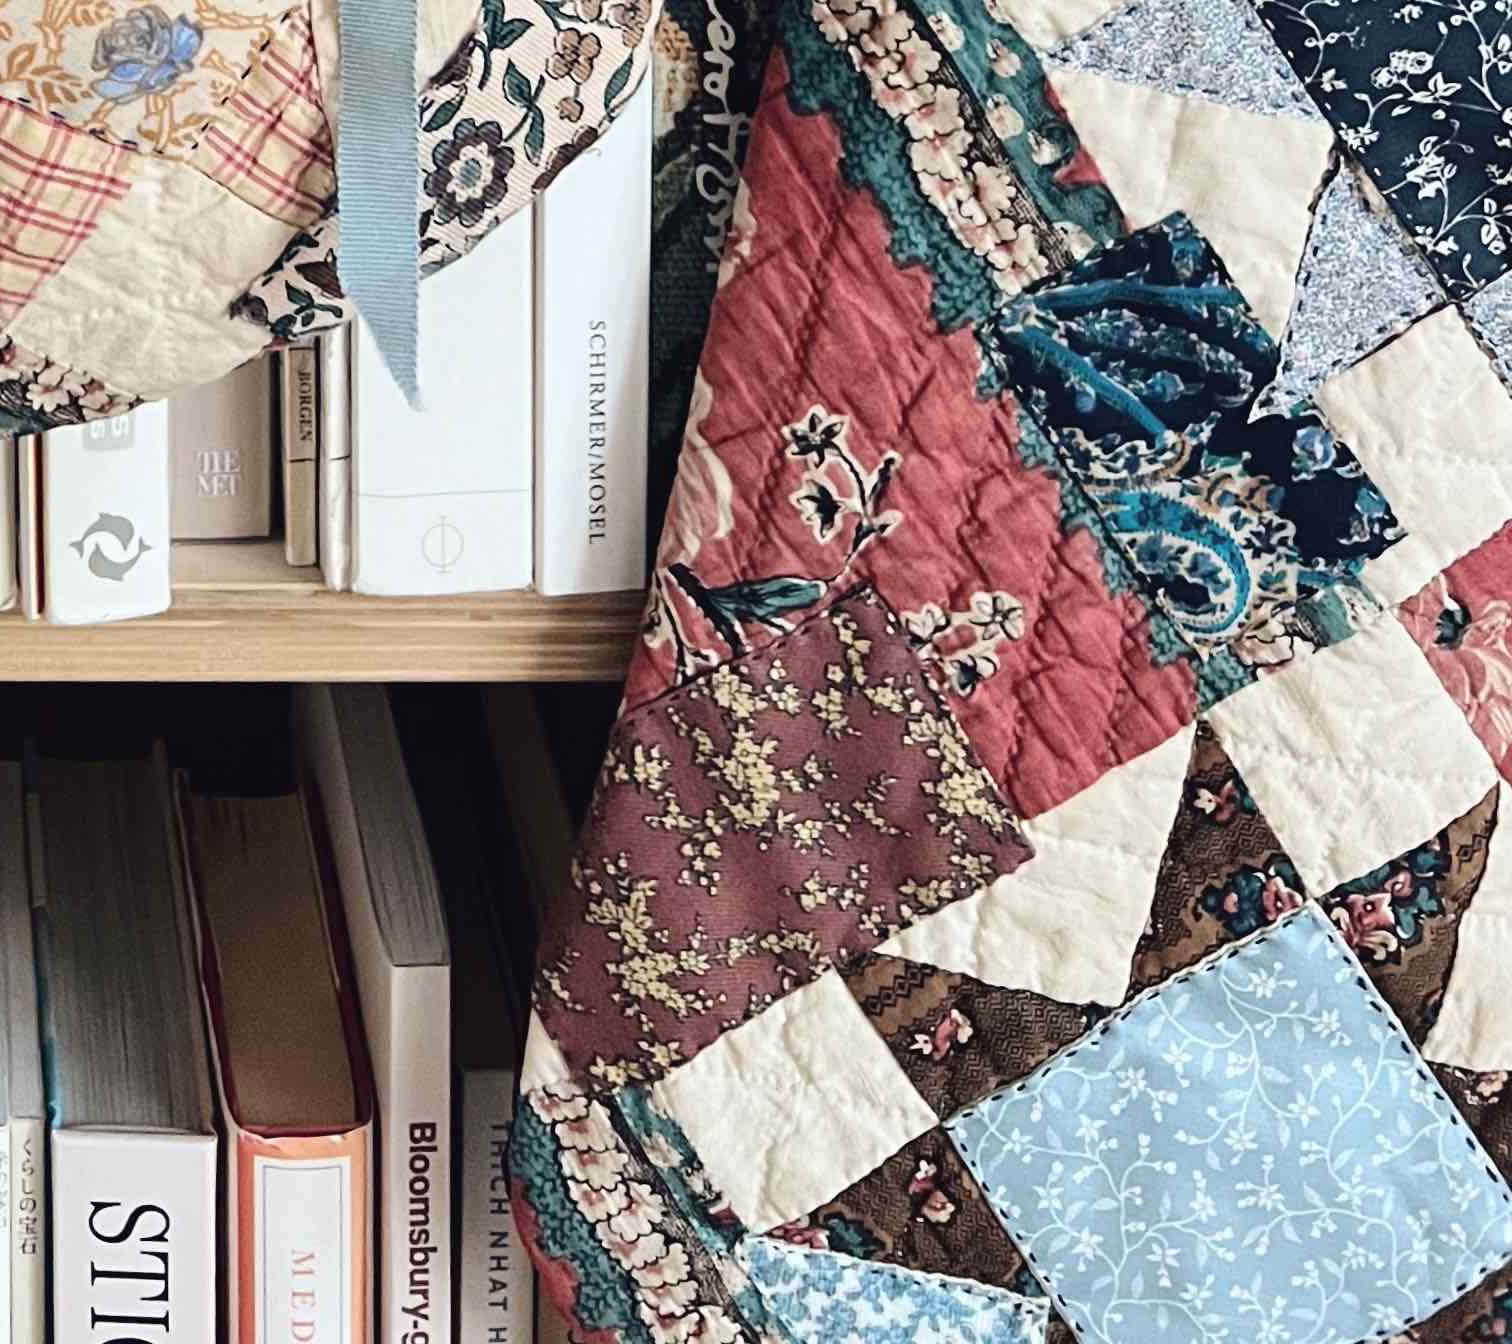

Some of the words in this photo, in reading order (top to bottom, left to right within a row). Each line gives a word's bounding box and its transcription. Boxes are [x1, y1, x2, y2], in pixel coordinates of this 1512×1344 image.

[587, 320, 607, 544] SCHIRMER/MOSEL
[87, 1200, 171, 1344] STI
[488, 1231, 509, 1312] NHAT
